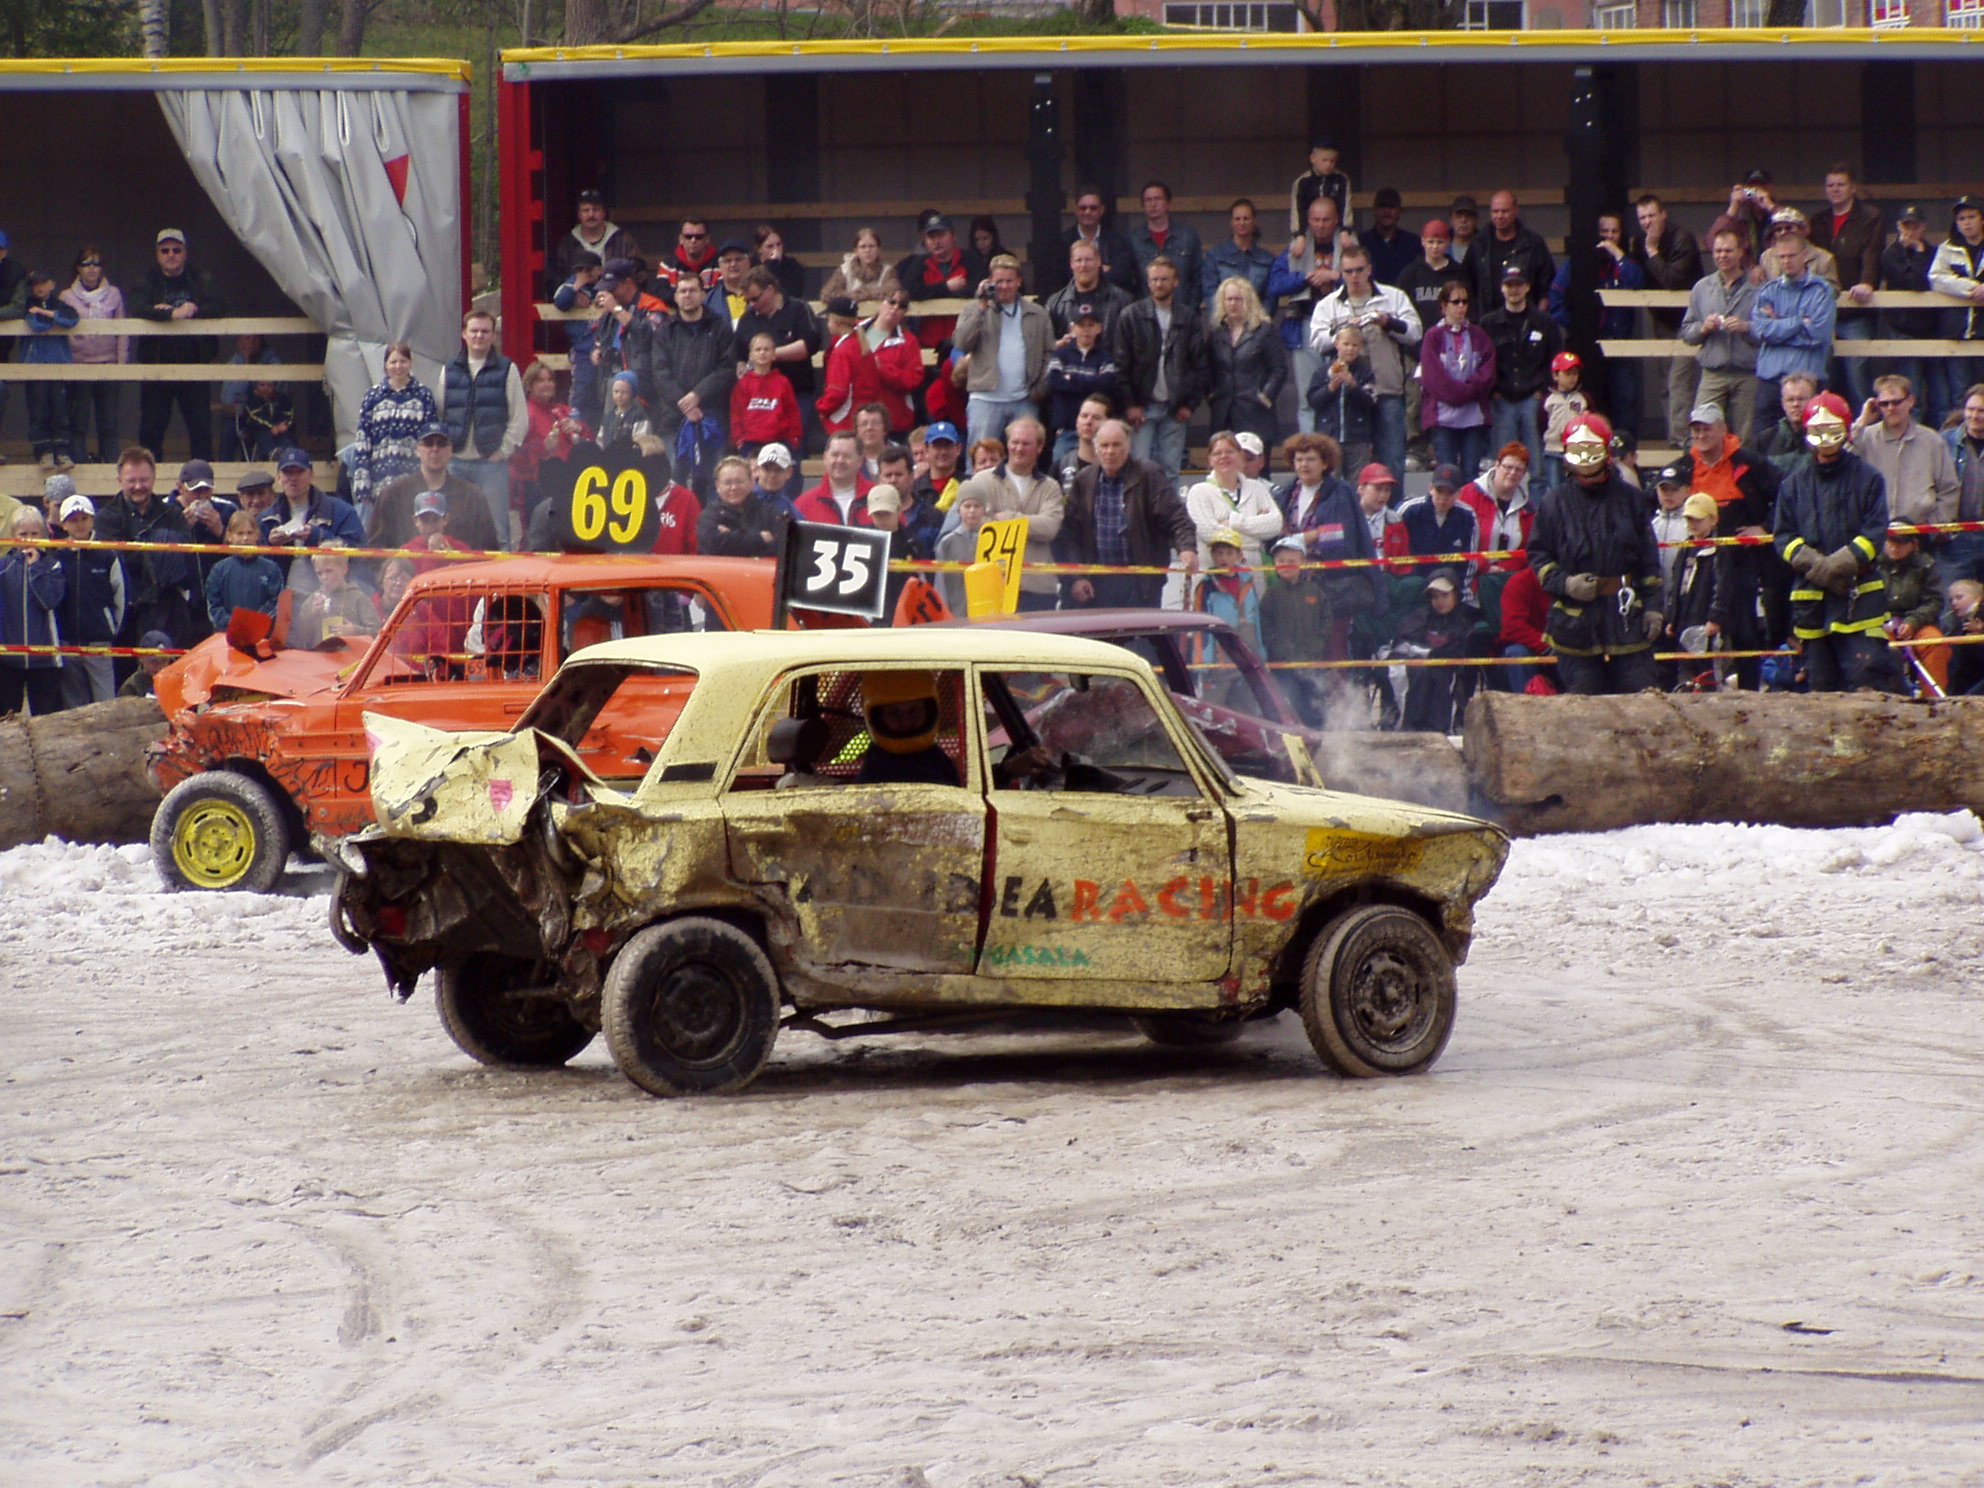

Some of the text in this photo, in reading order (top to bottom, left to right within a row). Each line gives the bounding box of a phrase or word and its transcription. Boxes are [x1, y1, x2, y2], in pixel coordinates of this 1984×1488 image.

[571, 465, 647, 544] 69
[806, 539, 872, 595] 35
[1070, 875, 1297, 923] RACING
